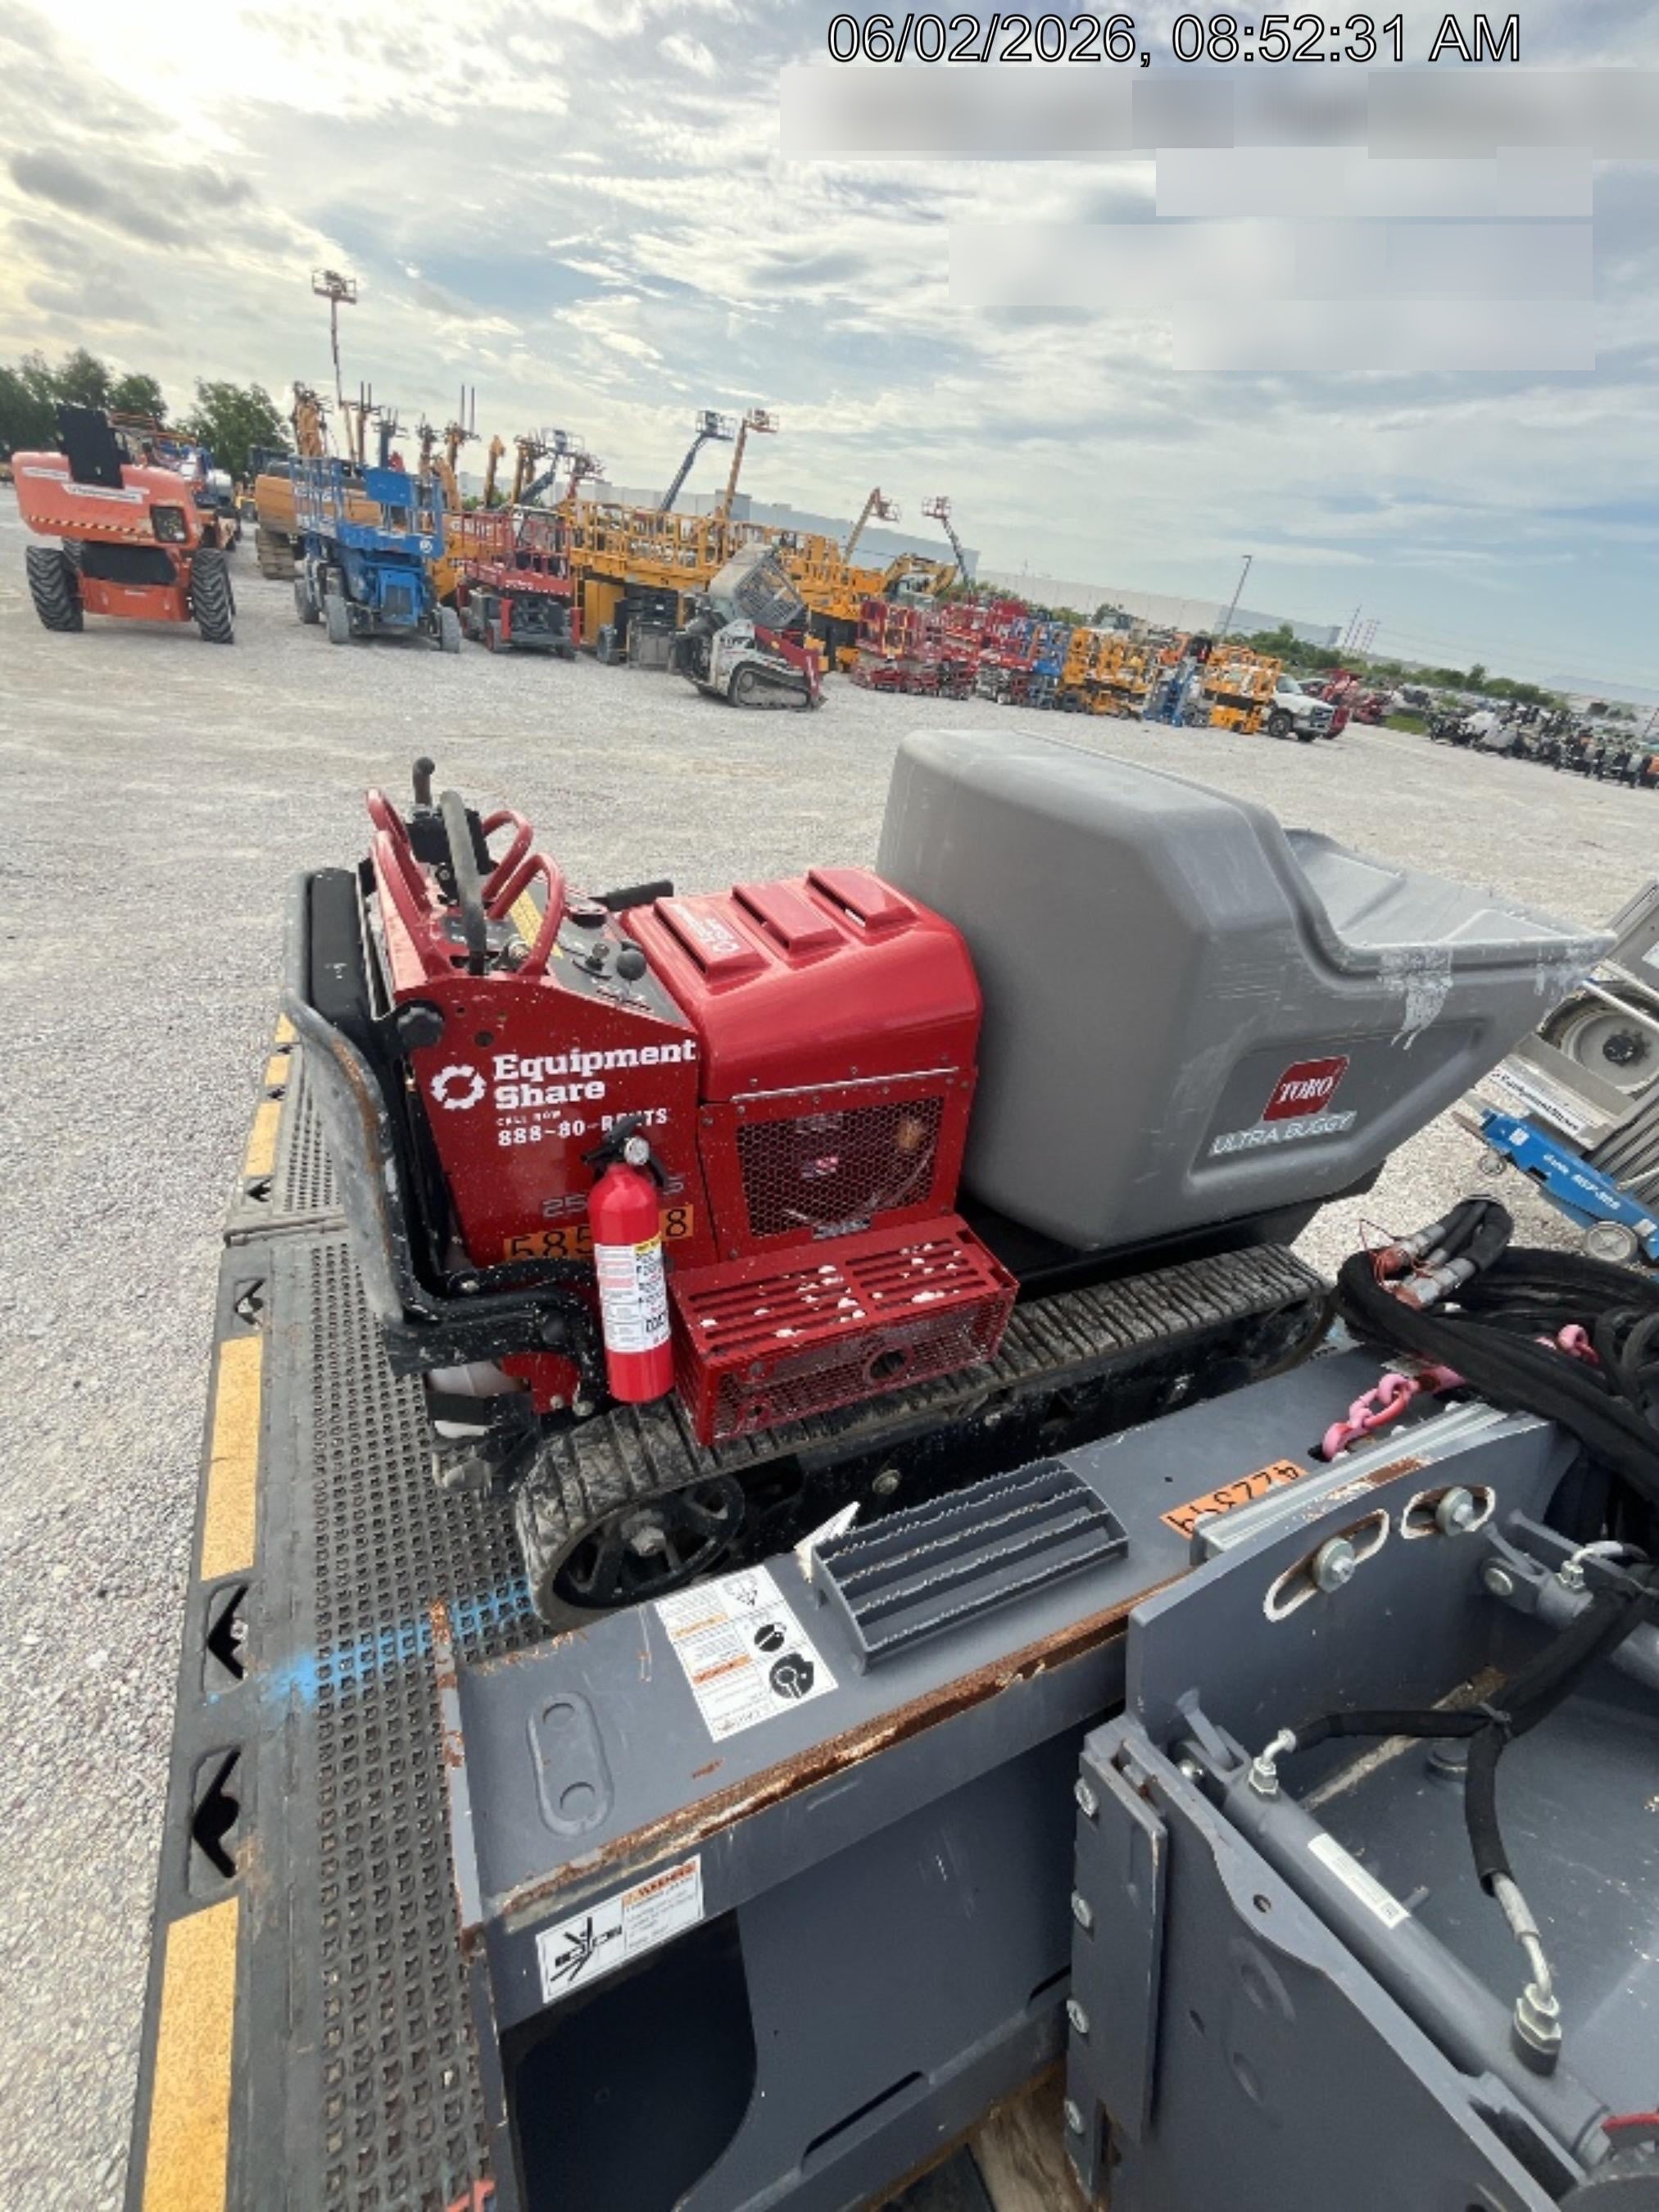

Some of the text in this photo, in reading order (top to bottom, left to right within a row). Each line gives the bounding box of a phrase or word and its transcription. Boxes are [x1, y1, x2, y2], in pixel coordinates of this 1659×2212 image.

[493, 1039, 696, 1081] Equipment
[493, 1078, 606, 1109] Share
[1276, 1076, 1334, 1104] TORO
[1213, 1110, 1358, 1154] ULTRA BUGGY
